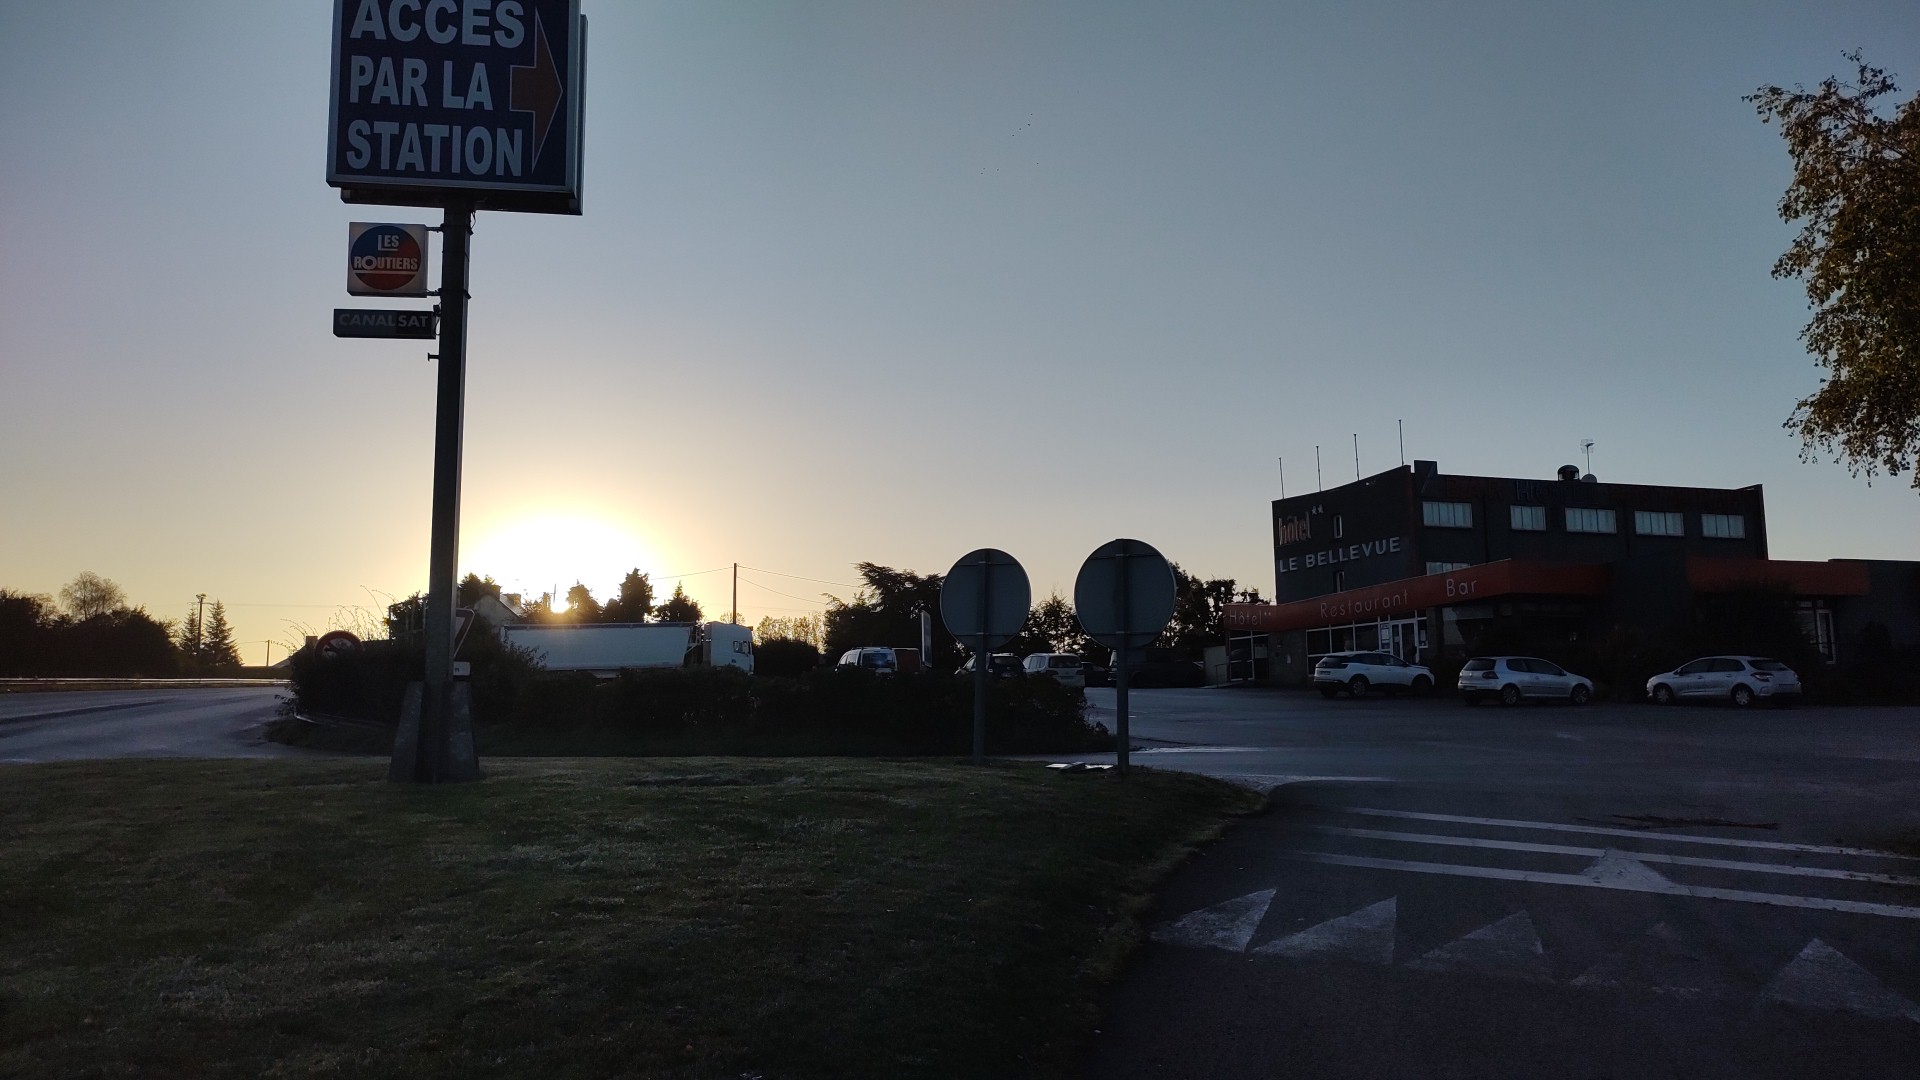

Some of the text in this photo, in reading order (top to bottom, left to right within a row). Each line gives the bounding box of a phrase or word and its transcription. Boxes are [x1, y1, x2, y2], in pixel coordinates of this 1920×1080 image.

[349, 55, 494, 111] PAR LA
[346, 119, 523, 177] STATION
[377, 234, 400, 251] LES
[353, 255, 419, 271] ROUTIERS
[1279, 536, 1401, 573] LE BELLEVUE
[1320, 590, 1408, 619] Restaurant
[1446, 578, 1478, 598] Bar
